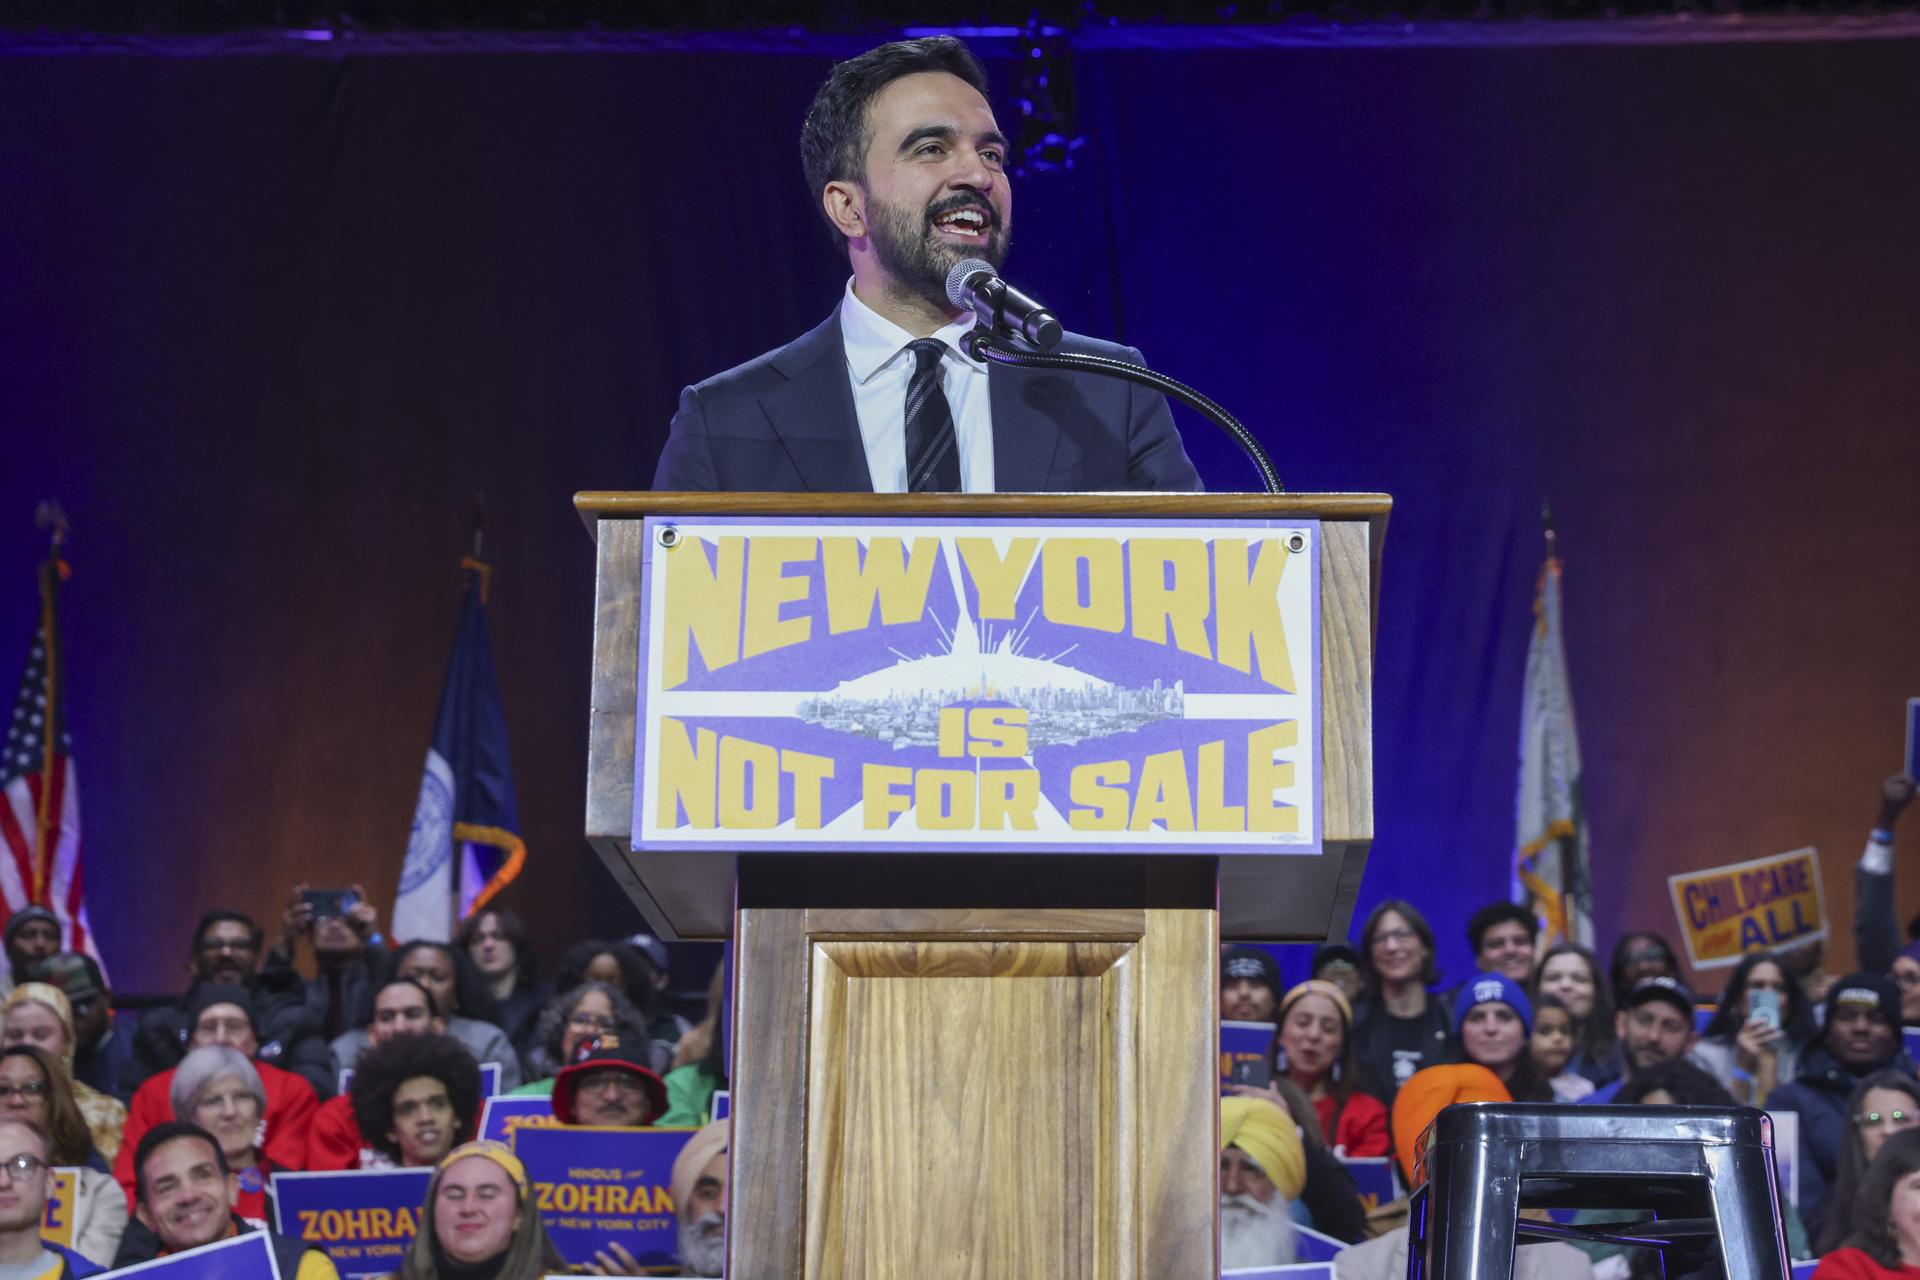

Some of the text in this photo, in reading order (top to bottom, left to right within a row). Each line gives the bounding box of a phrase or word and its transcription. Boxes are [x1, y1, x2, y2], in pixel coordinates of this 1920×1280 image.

[662, 536, 1298, 695] NEW YORK
[939, 707, 1028, 758] IS
[656, 716, 1299, 833] NOT FOR SALE
[1740, 900, 1814, 951] ALL
[533, 1182, 675, 1214] ZOHRAN
